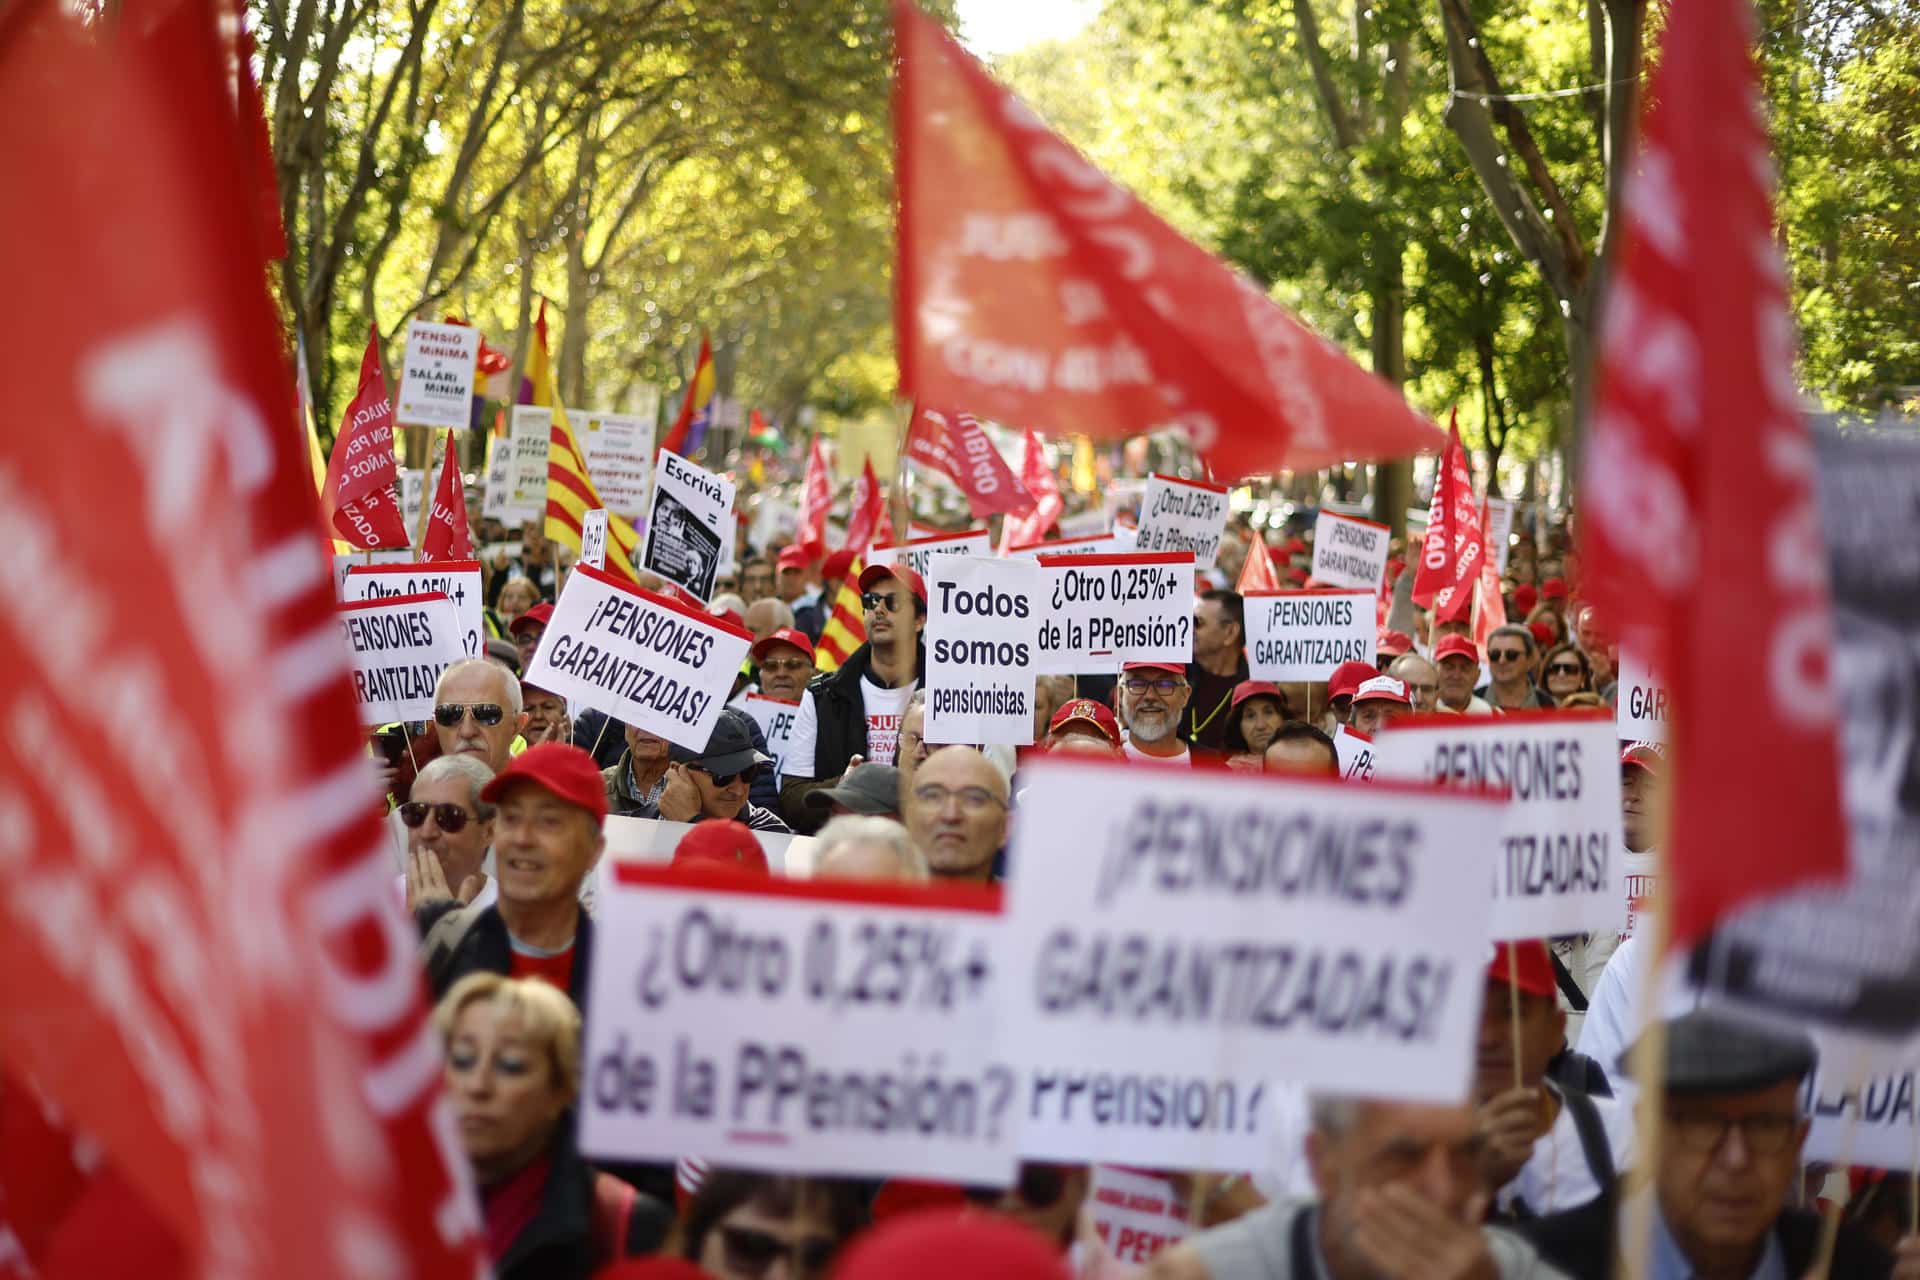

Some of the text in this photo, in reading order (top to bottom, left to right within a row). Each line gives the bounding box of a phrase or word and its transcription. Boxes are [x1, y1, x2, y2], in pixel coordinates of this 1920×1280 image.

[665, 457, 726, 508] Escrivà,
[937, 581, 1030, 619] Todos
[1051, 567, 1177, 610] ¿Otro 0,25%+
[584, 595, 714, 669] ¡PENSIONES
[1038, 615, 1189, 650] de la PPensión?
[1267, 600, 1353, 633] ¡PENSIONES
[934, 638, 1030, 667] somos
[1255, 639, 1368, 665] GARANTIZADAS!
[549, 634, 712, 727] GARANTIZADAS!
[932, 681, 1028, 721] pensionistas.
[1426, 740, 1583, 801] PENSIONES
[1497, 833, 1609, 898] TIZADAS!
[637, 907, 988, 1016] ¿Otro 0,25%+
[593, 1034, 656, 1114] de
[672, 1035, 716, 1120] la
